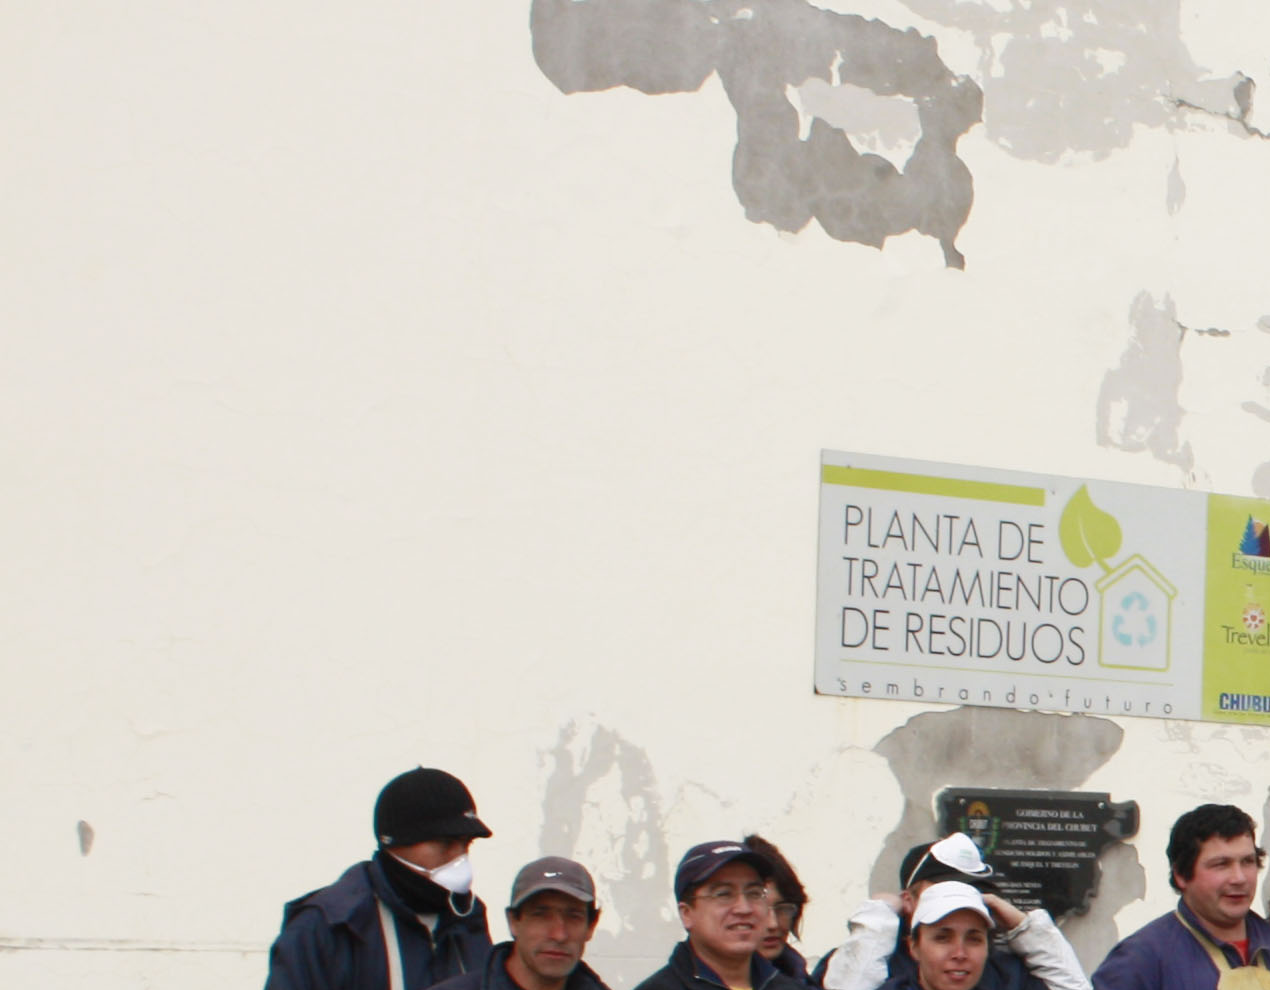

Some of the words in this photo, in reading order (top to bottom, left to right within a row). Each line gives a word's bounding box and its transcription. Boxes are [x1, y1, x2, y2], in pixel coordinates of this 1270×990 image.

[843, 505, 983, 559] PLANTA
[998, 521, 1046, 564] DE
[843, 557, 1090, 617] TRATAMIENTO
[840, 607, 891, 651] DE
[905, 617, 1088, 666] RESIDUOS
